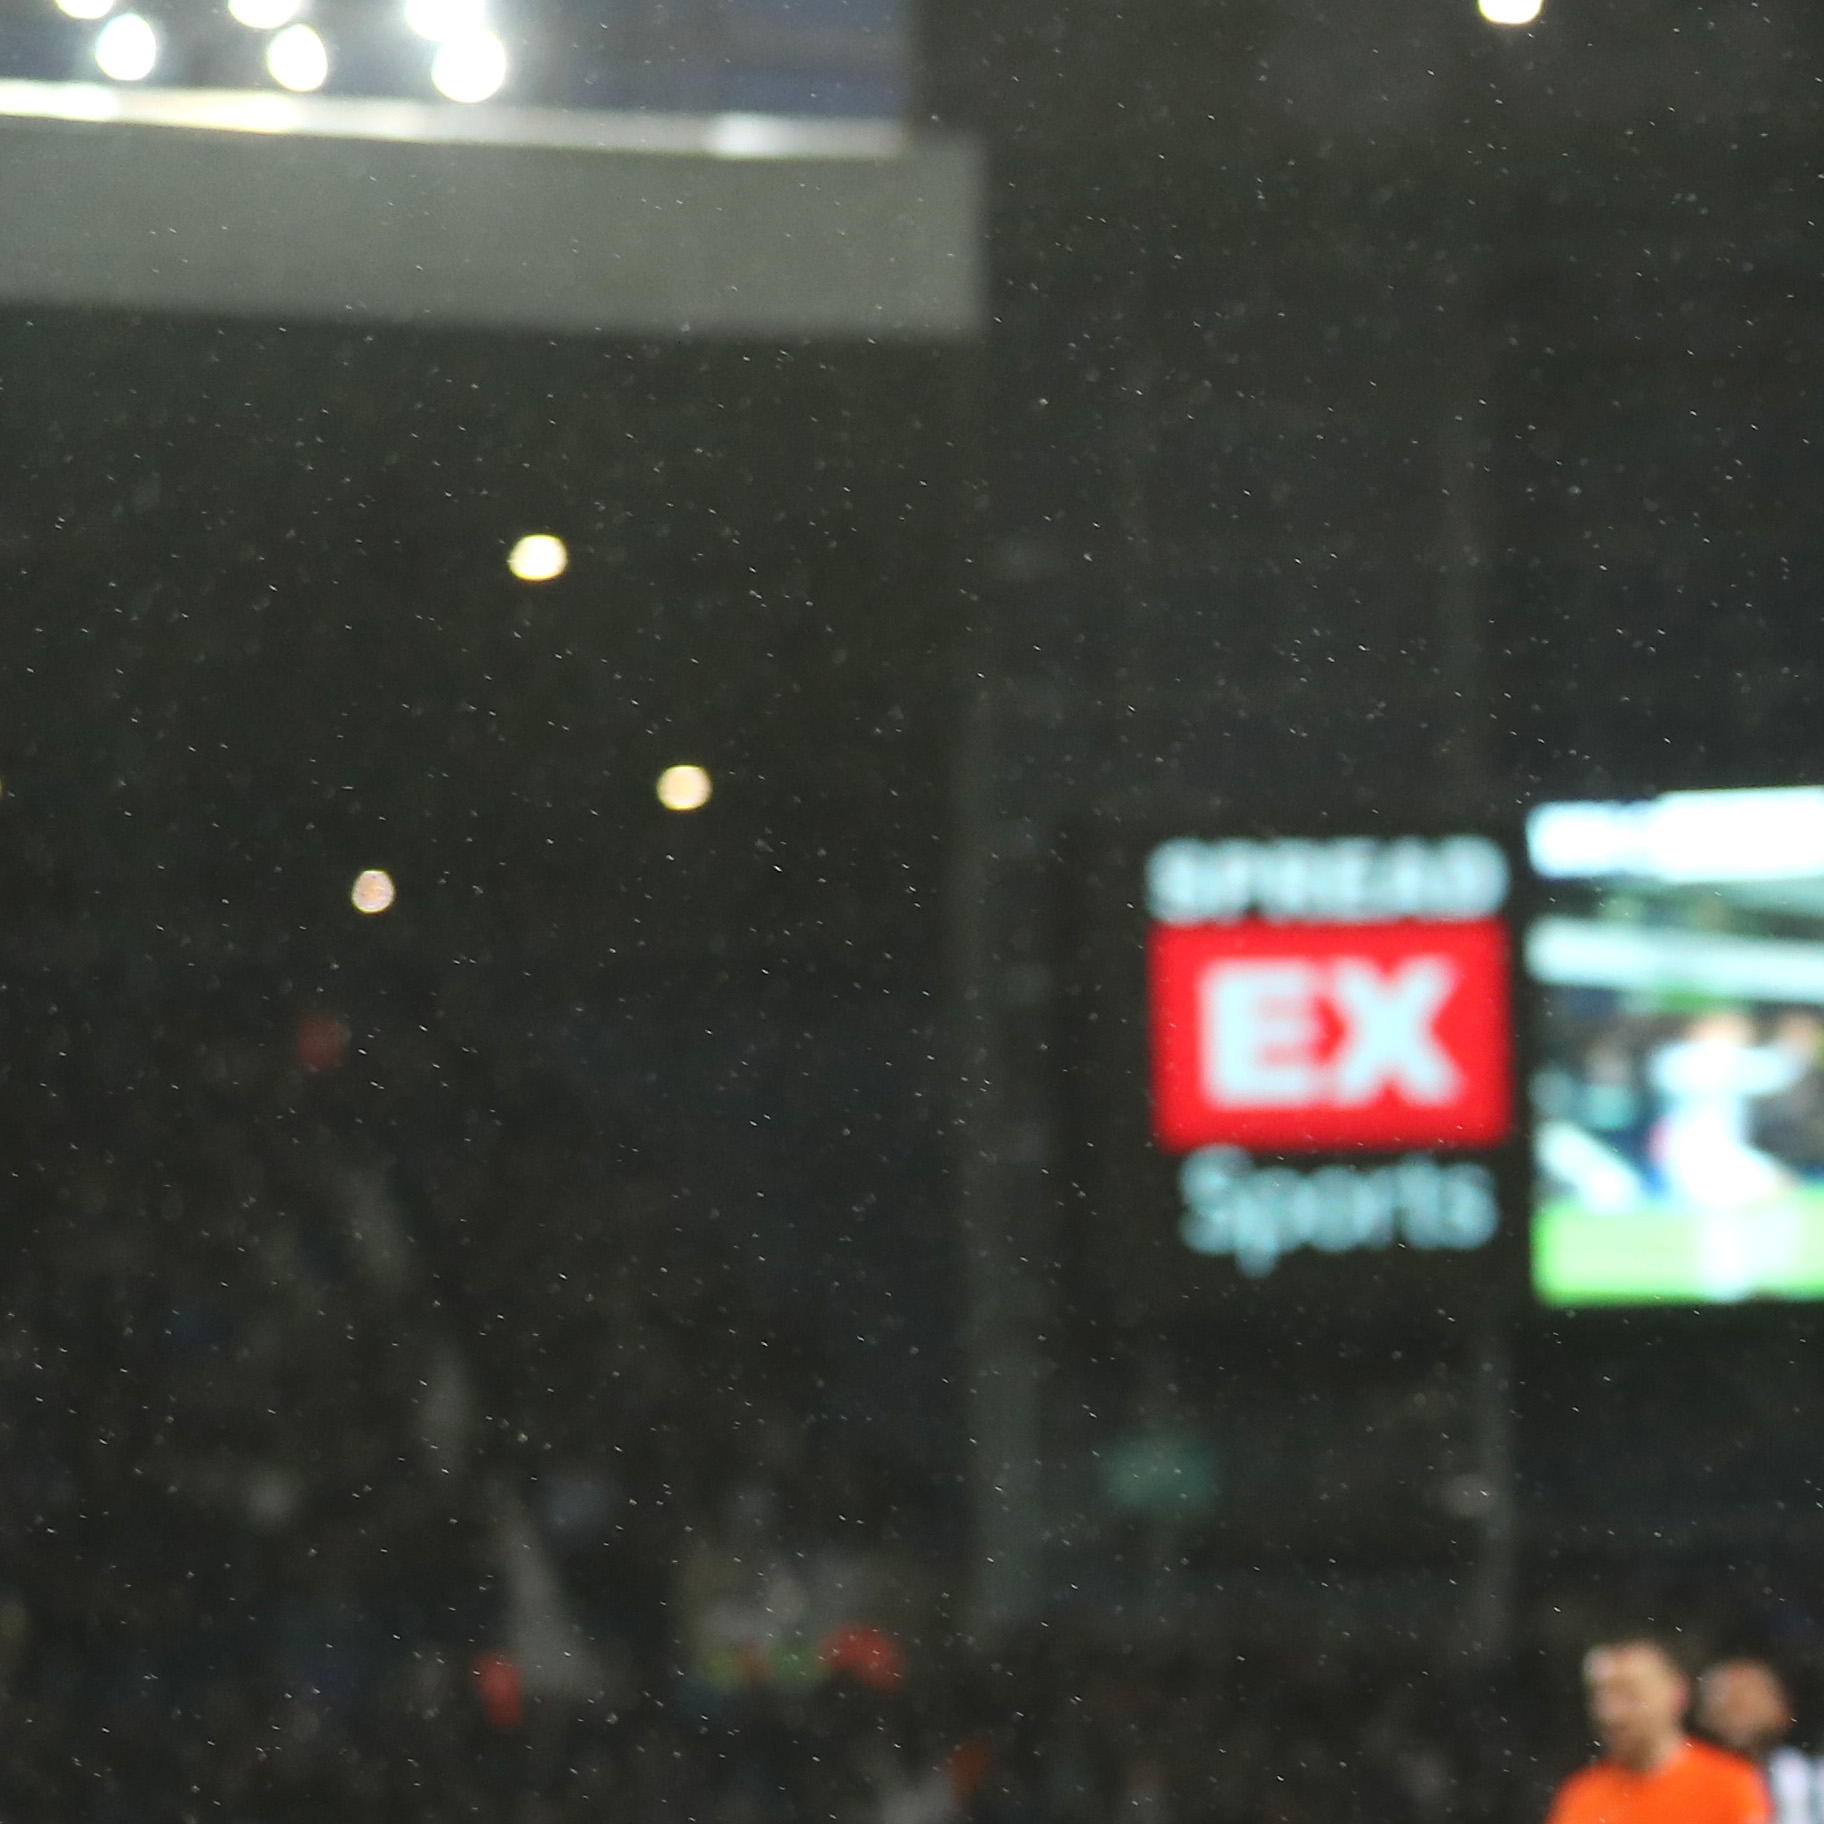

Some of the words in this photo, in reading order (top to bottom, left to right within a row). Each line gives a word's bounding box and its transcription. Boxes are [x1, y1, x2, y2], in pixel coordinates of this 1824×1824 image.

[1146, 837, 1509, 926] SPREAD
[1201, 955, 1464, 1110] EX
[1180, 1144, 1499, 1277] Sports
